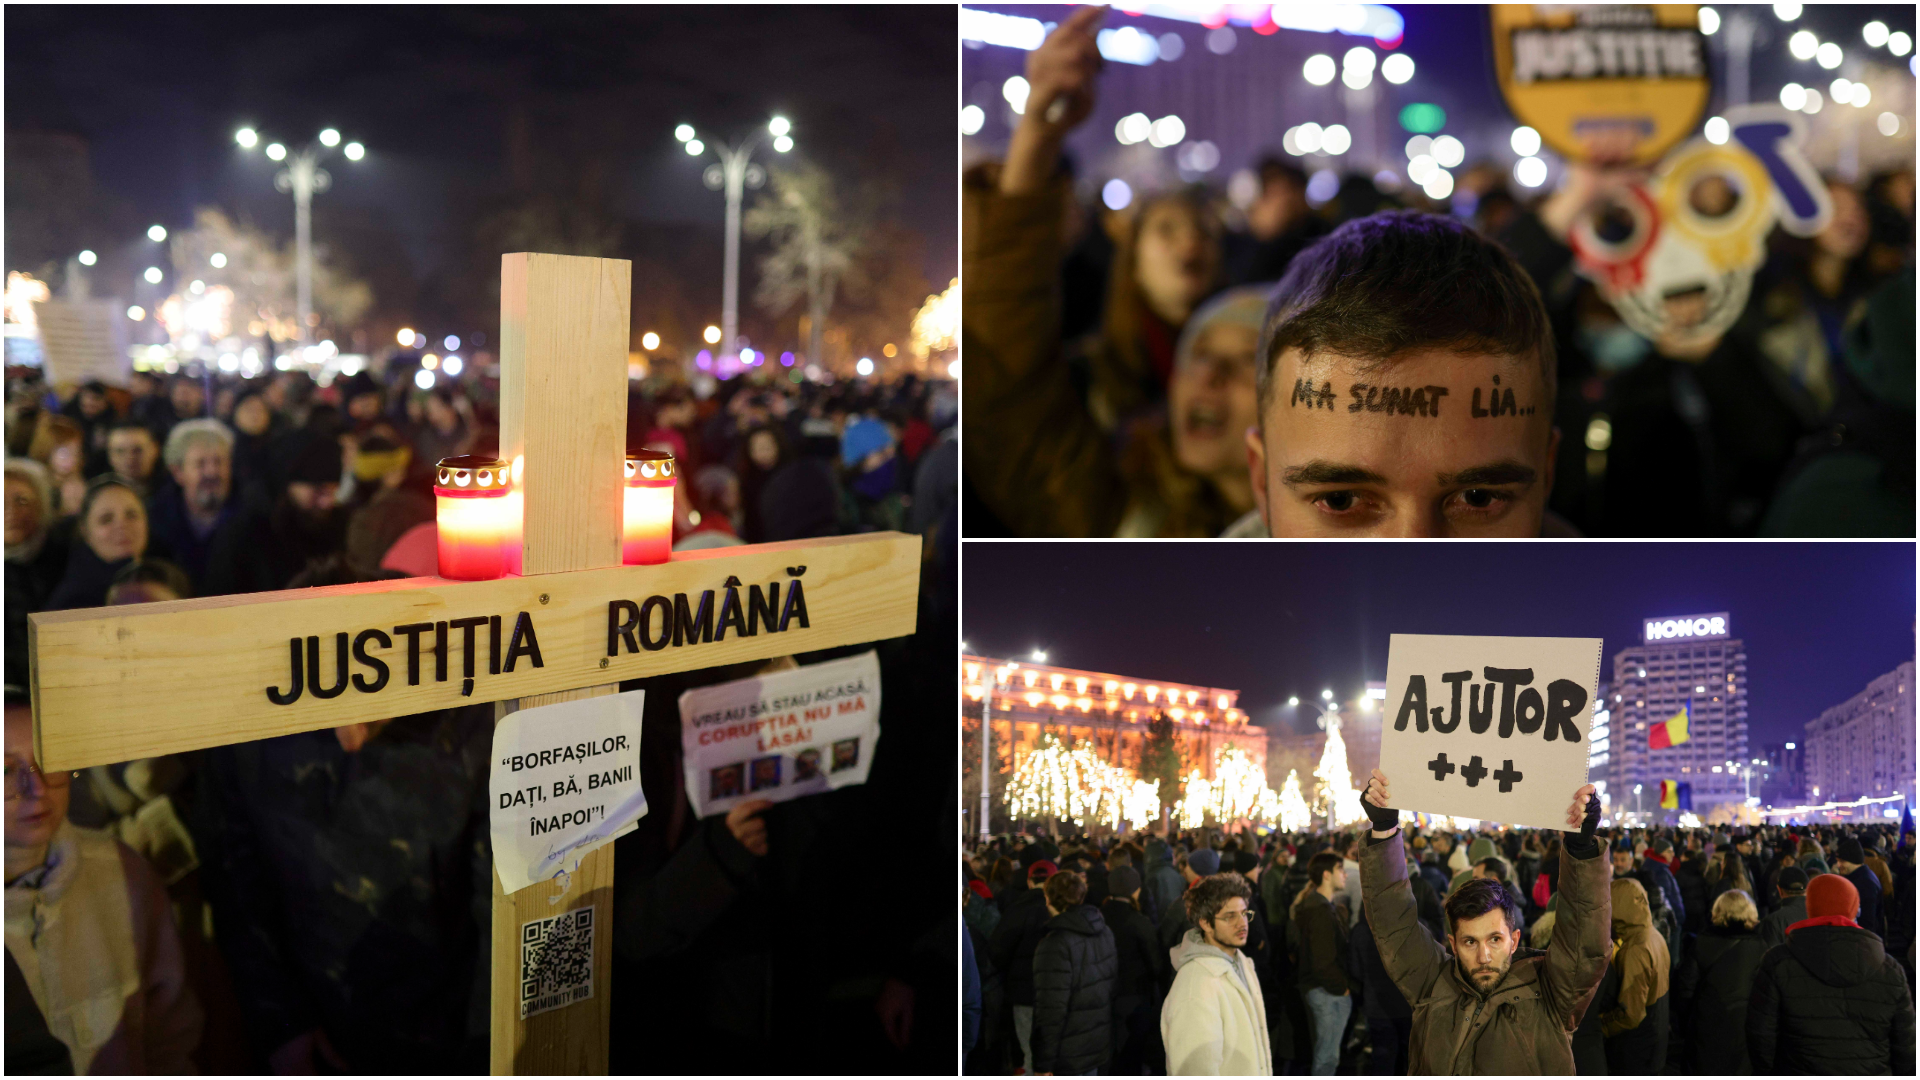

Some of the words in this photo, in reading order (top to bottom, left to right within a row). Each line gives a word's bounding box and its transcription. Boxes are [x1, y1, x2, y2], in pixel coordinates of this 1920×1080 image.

[1291, 378, 1336, 412] MA
[266, 611, 544, 706] JUSTIȚIA
[607, 565, 810, 657] ROMÂNĂ
[1646, 616, 1726, 641] HONOR
[692, 706, 747, 728] VREAU
[772, 694, 812, 713] STAU
[804, 705, 832, 724] NU
[1394, 665, 1588, 744] AJUTOR
[499, 785, 547, 809] DAȚI,
[553, 774, 582, 798] BĂ,
[588, 765, 632, 790] BANII
[522, 991, 571, 1015] COMMUNITY
[573, 985, 589, 1000] HUB
